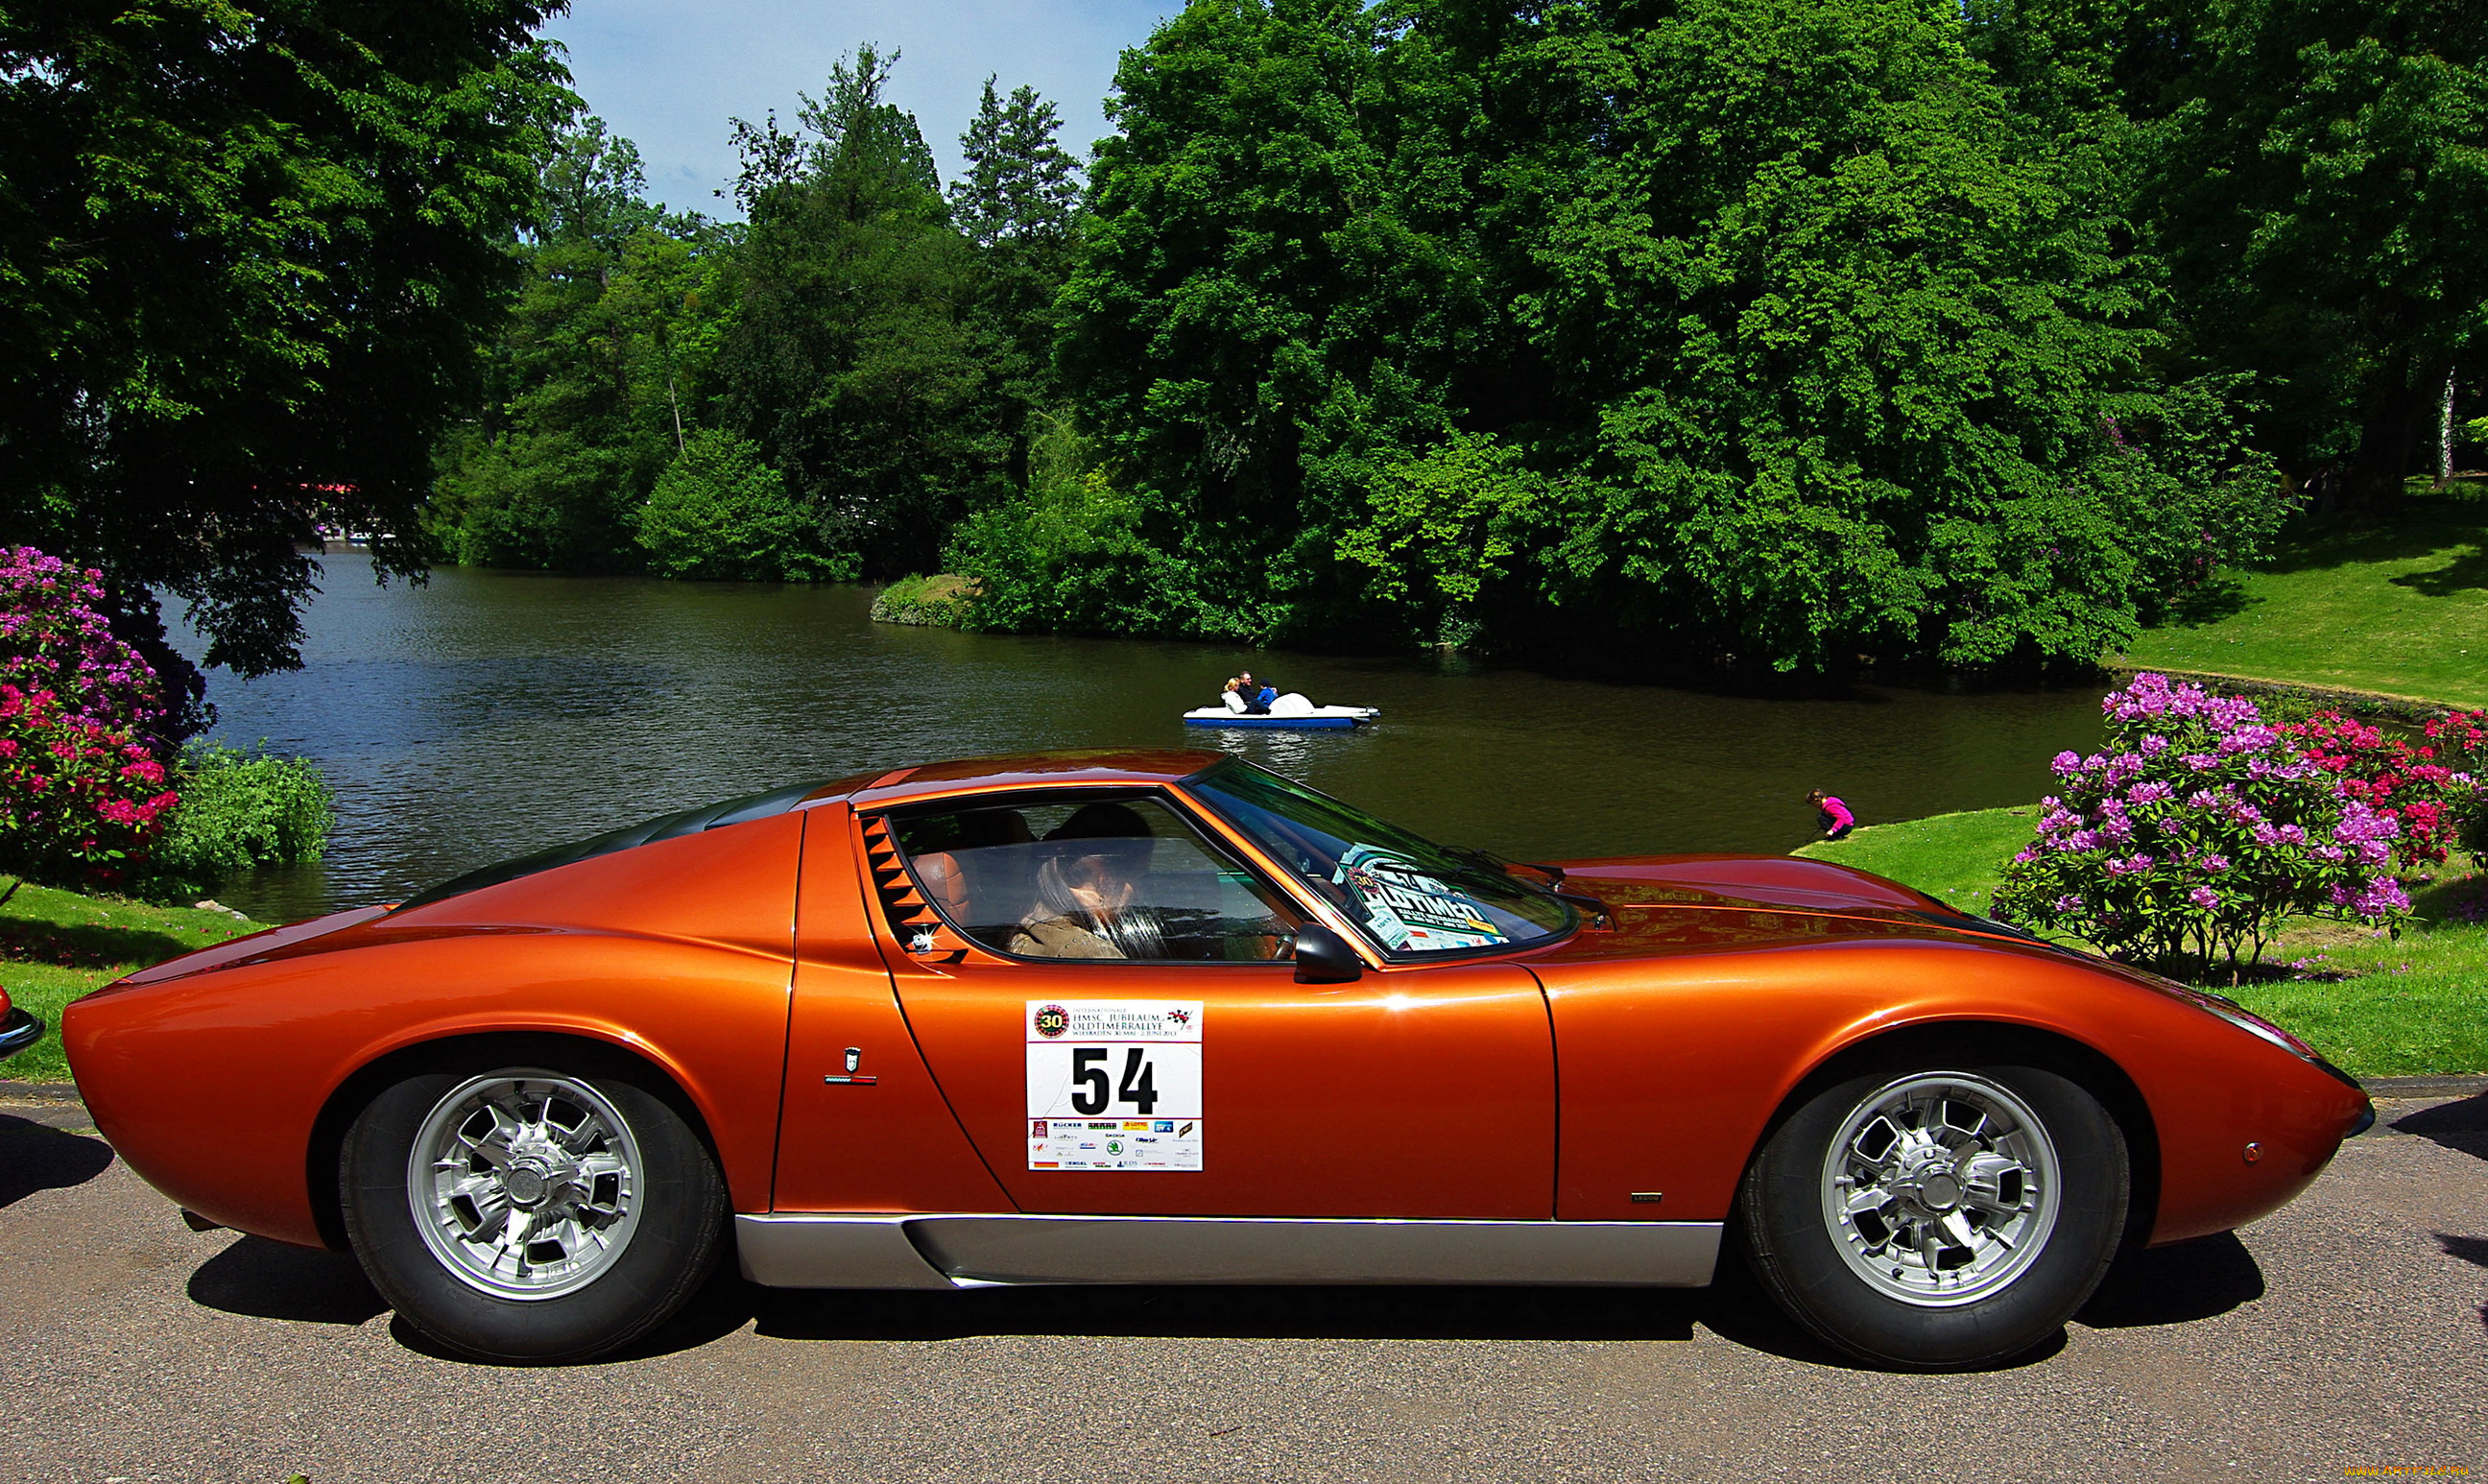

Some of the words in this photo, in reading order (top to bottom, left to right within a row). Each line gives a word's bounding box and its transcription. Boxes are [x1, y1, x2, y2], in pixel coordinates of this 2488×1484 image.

[1353, 874, 1375, 887] 30
[1041, 1015, 1063, 1028] 30
[1071, 1048, 1159, 1115] 54
